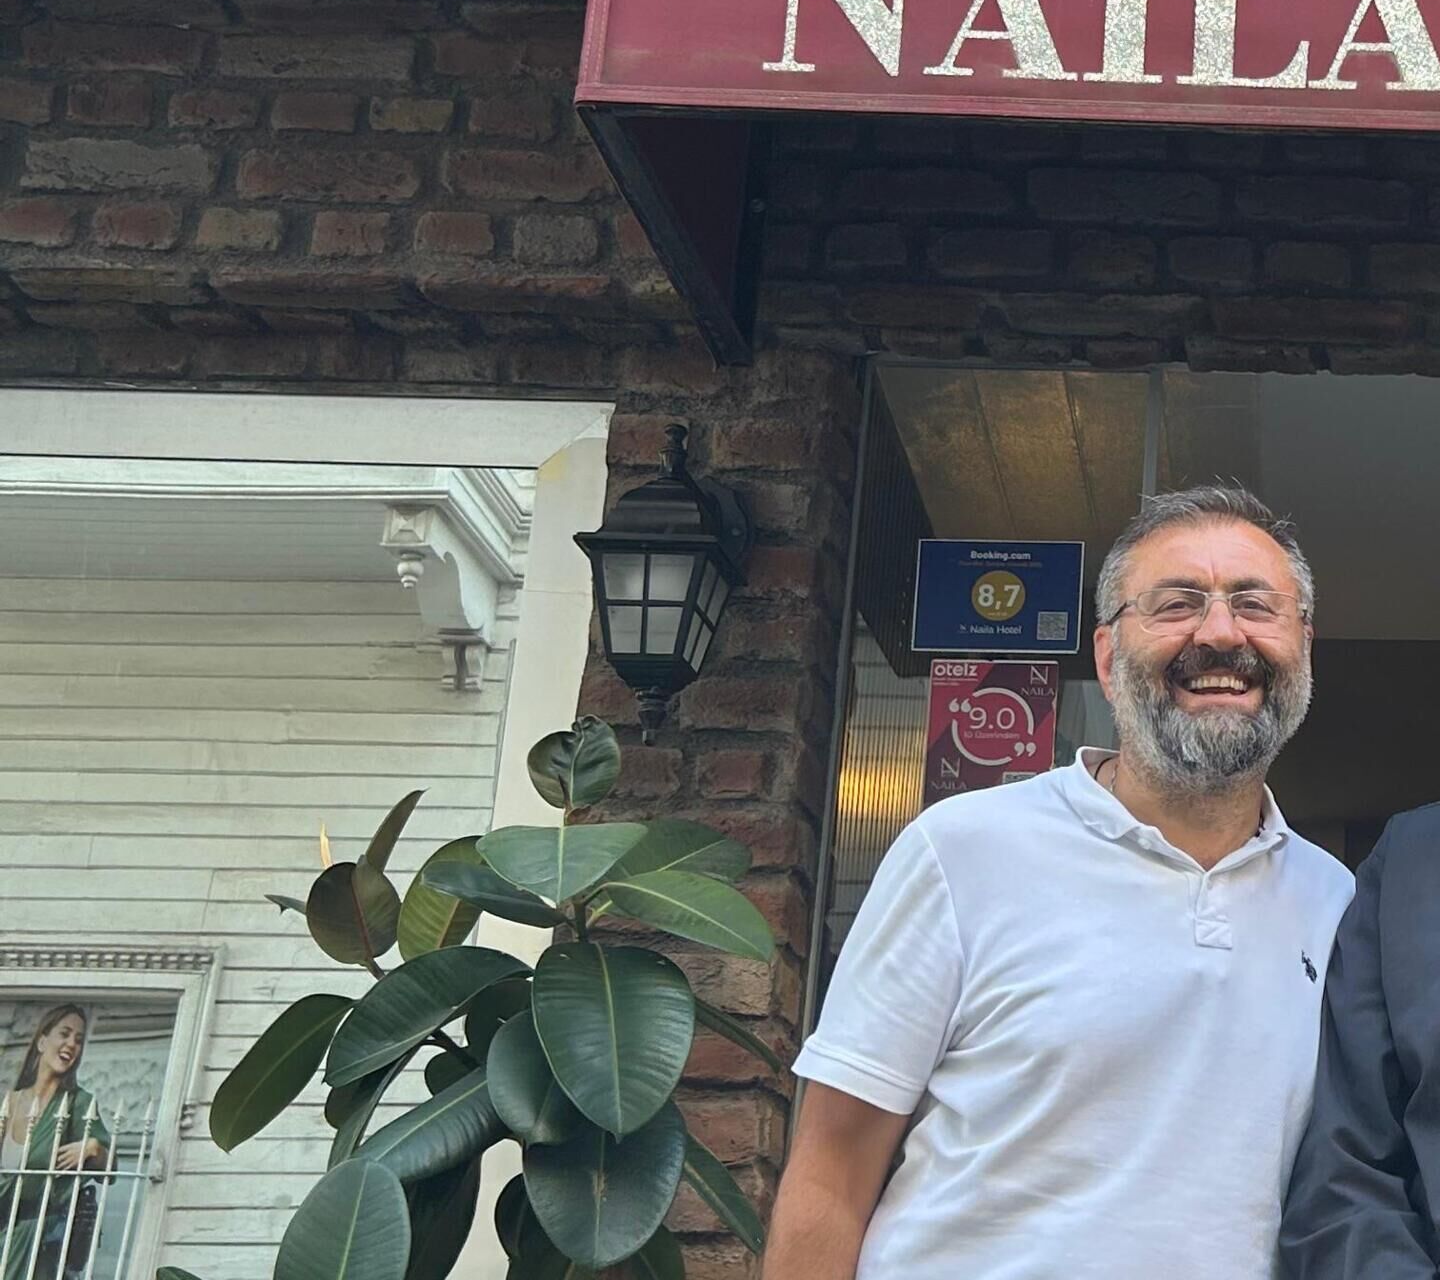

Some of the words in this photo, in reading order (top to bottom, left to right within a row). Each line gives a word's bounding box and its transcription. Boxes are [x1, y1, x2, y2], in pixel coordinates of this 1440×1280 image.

[970, 550, 1031, 561] Booking.com
[978, 584, 1020, 610] 8,7
[970, 624, 994, 634] Naila
[997, 624, 1022, 634] Hotel
[934, 663, 978, 677] otelz
[1020, 687, 1055, 697] NAILA
[969, 707, 1015, 729] 9.0
